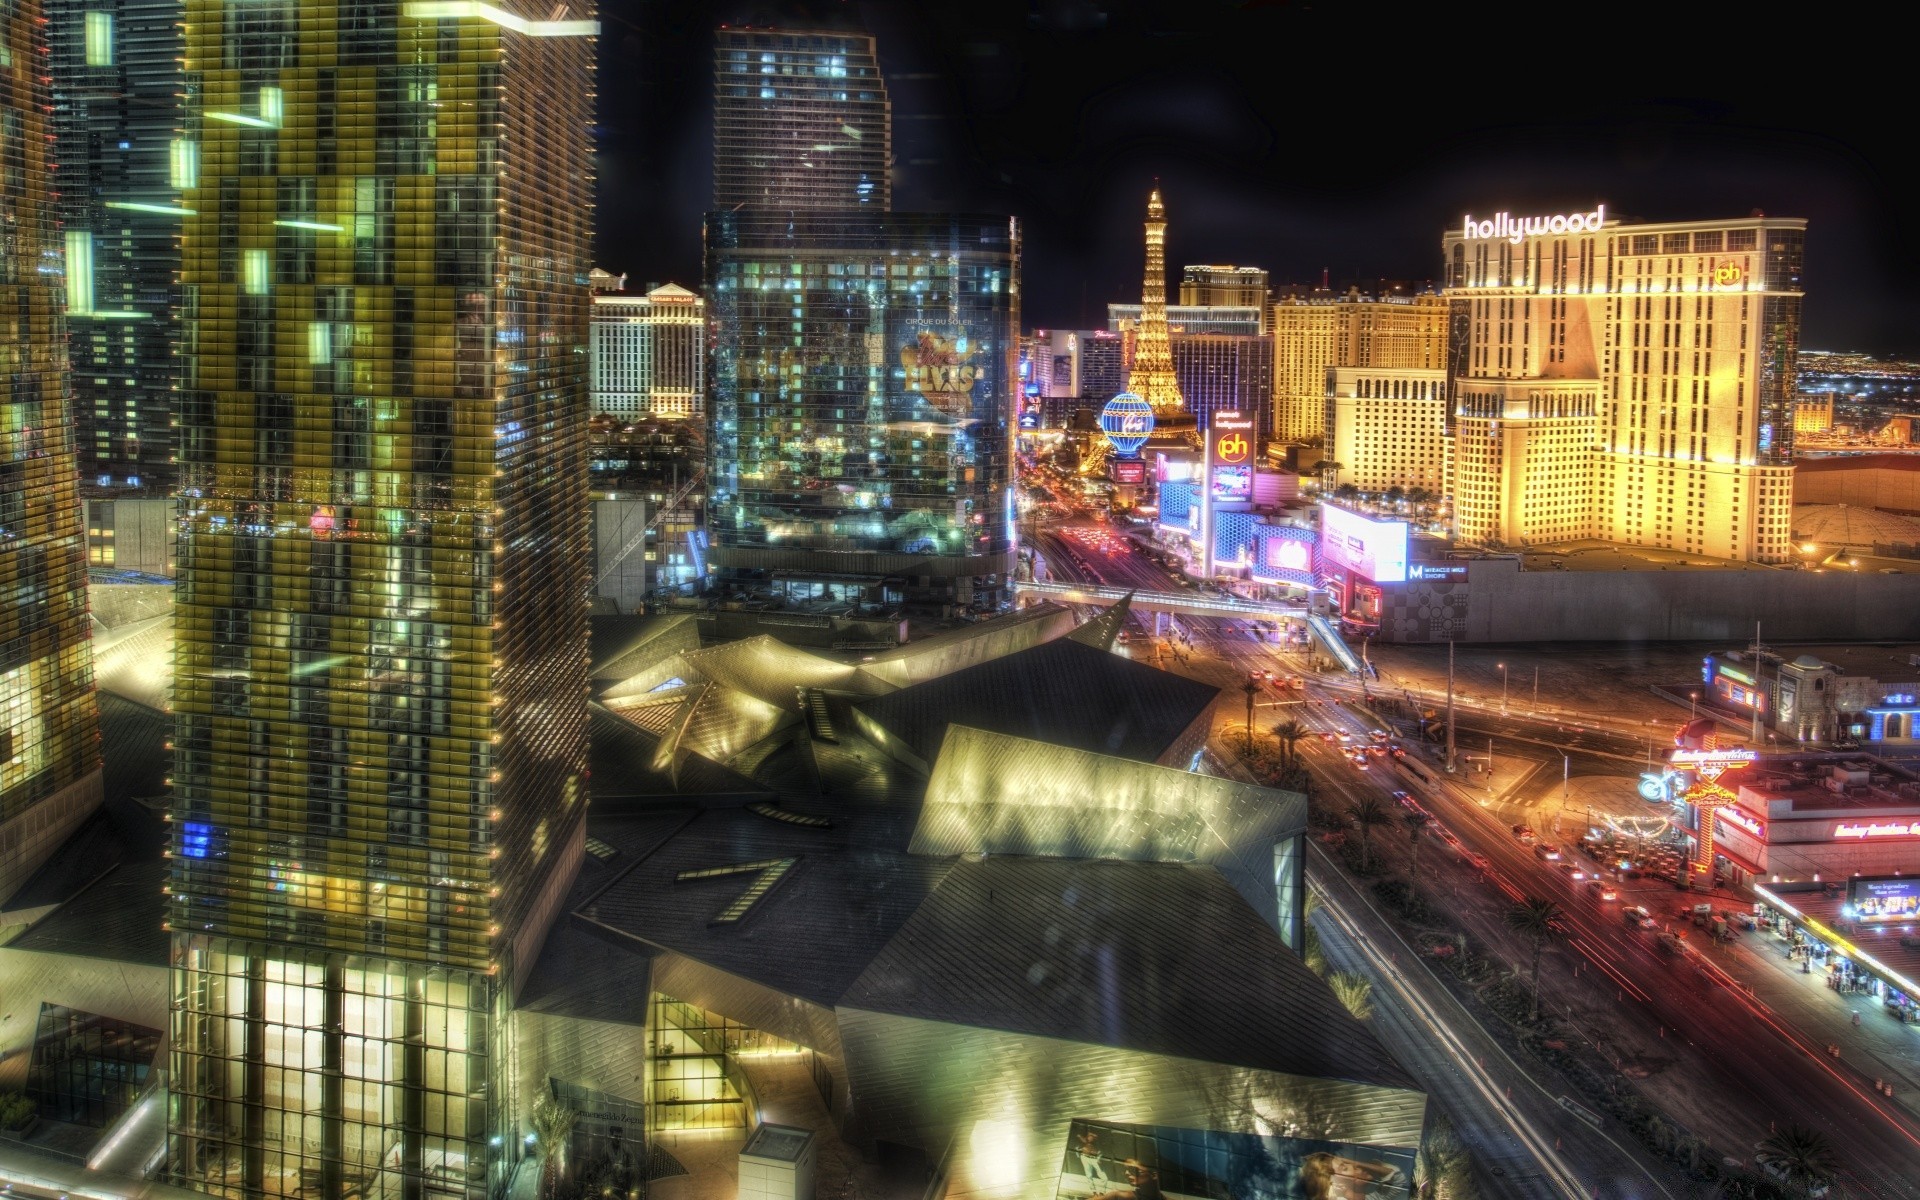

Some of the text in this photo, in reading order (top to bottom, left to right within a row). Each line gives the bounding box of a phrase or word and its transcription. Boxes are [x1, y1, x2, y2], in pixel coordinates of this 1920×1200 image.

[1464, 205, 1604, 244] hollywood
[1717, 262, 1740, 286] ph
[905, 318, 934, 326] CIRQUE
[904, 365, 975, 392] ELVIS
[1215, 411, 1240, 419] planet
[1215, 421, 1252, 429] hollywood
[1220, 433, 1248, 459] ph
[620, 1113, 645, 1125] Zegna
